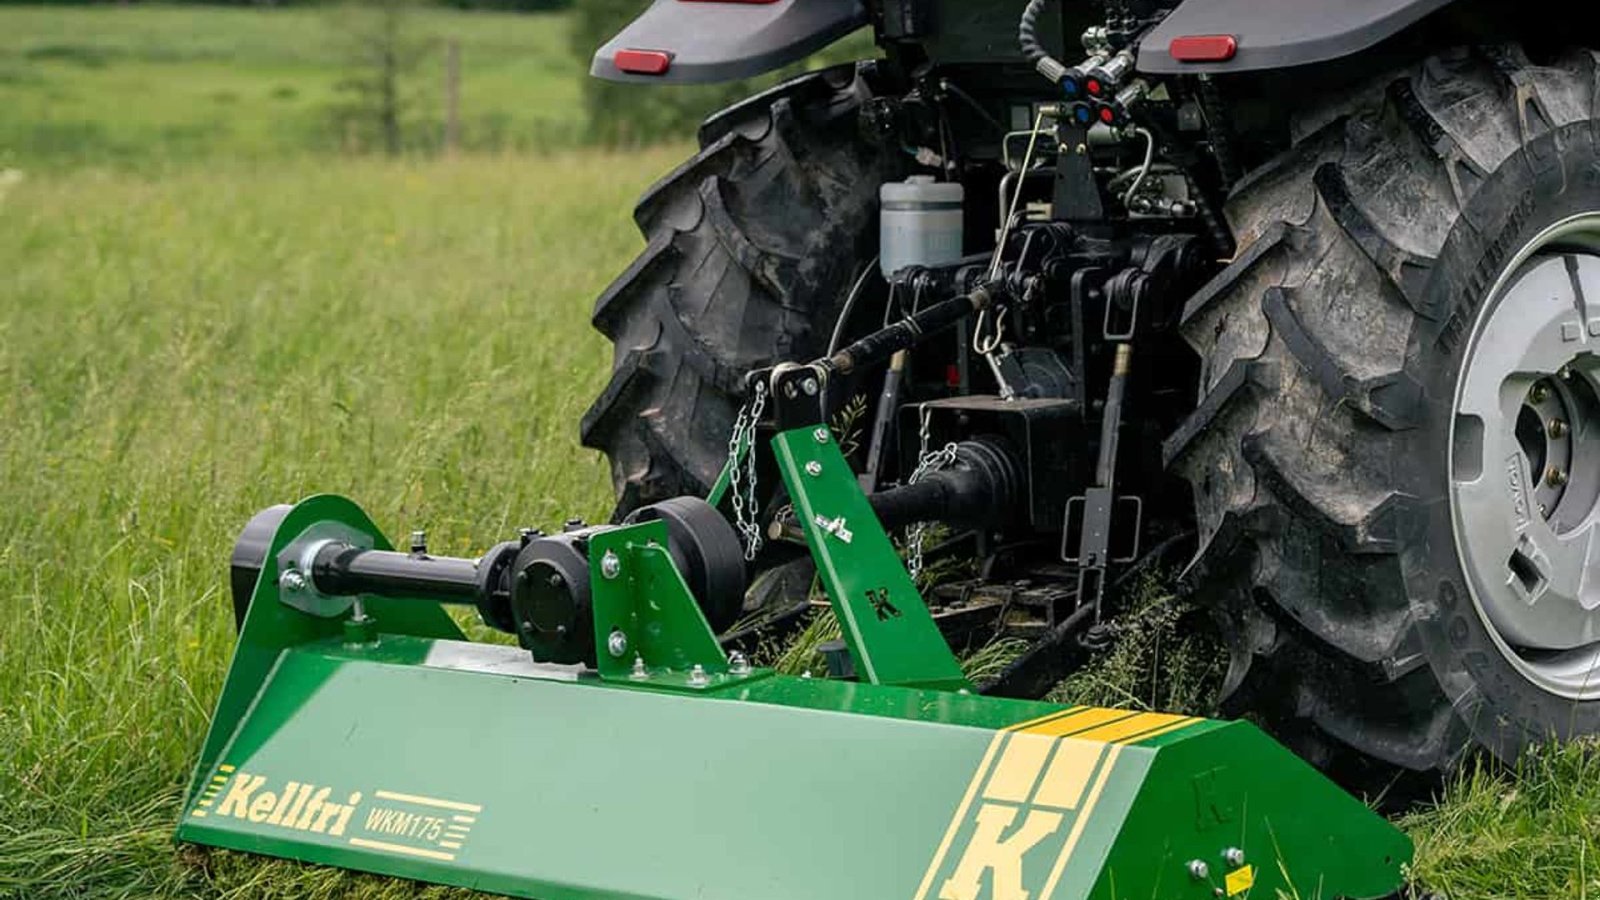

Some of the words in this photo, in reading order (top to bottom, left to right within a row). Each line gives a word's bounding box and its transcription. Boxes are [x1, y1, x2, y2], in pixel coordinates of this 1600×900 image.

[864, 586, 902, 622] K
[217, 774, 362, 836] Kellfri
[365, 807, 446, 841] WKM175
[938, 803, 1064, 900] K
